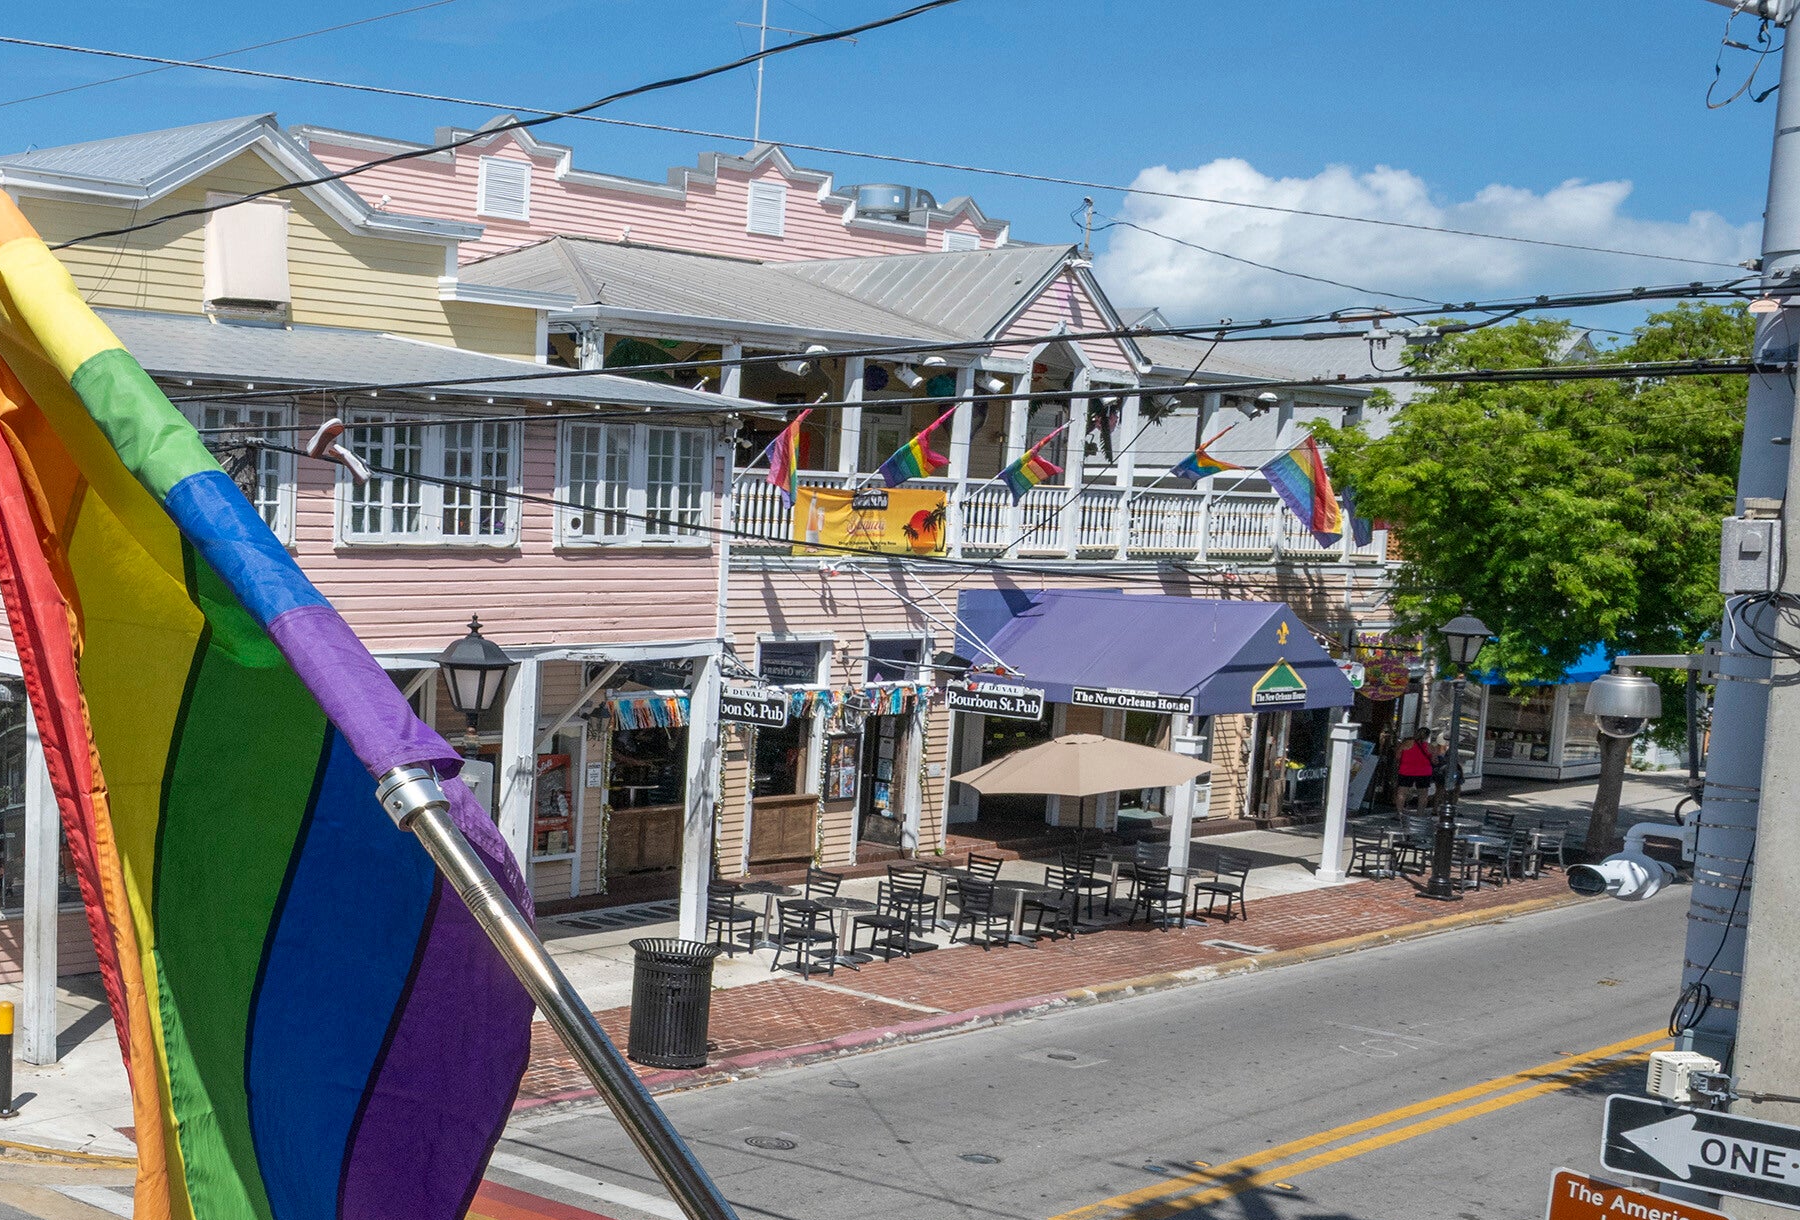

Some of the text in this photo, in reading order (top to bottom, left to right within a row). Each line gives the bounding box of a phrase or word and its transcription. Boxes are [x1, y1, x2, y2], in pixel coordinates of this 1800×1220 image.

[732, 688, 763, 699] DUVAL
[988, 684, 1019, 694] DUVAL
[743, 702, 758, 718] St.
[760, 703, 783, 721] Pub
[948, 690, 1039, 714] Bourbon St. Pub
[1075, 690, 1093, 703] The
[1095, 692, 1117, 704] New
[1117, 695, 1156, 709] Orleans
[1157, 698, 1190, 712] House
[1700, 1138, 1786, 1179] ONE
[1567, 1180, 1604, 1207] The
